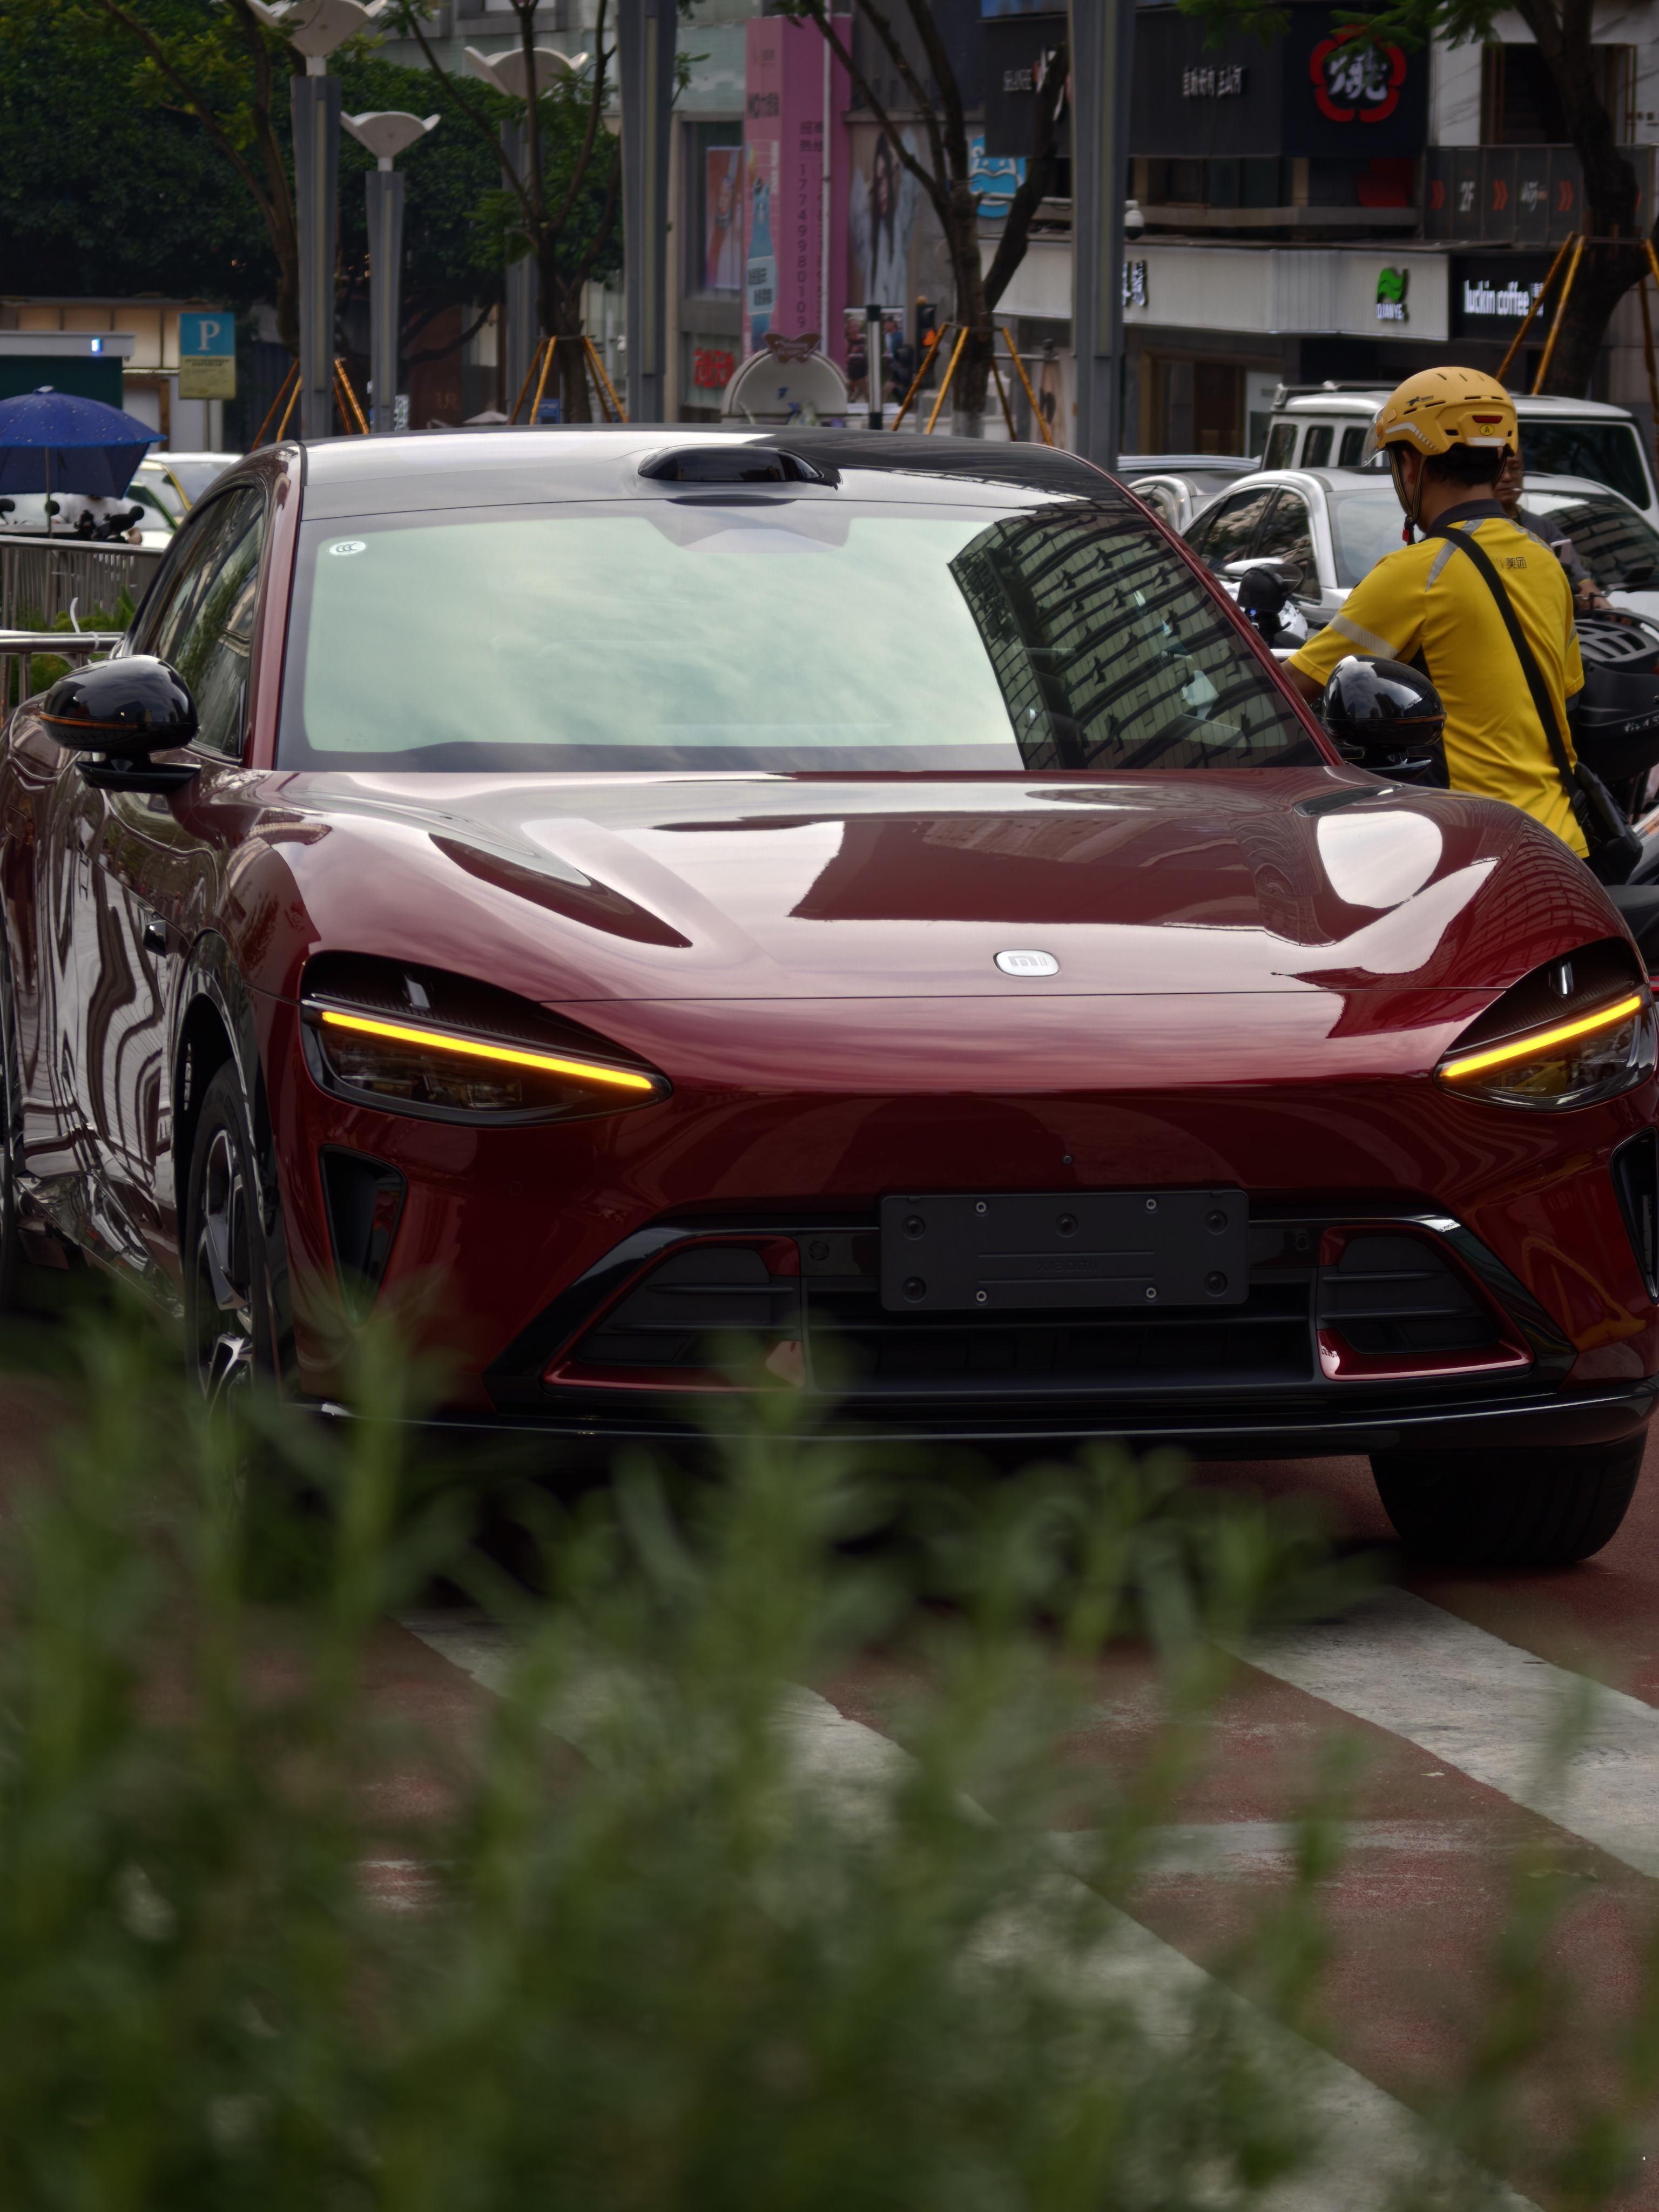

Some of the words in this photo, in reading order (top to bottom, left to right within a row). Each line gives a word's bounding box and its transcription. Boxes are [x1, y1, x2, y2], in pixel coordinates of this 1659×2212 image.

[1464, 280, 1495, 315] luckin
[1496, 281, 1529, 317] coffee
[198, 320, 221, 351] P
[1484, 426, 1491, 434] A
[1506, 557, 1527, 570] 美团
